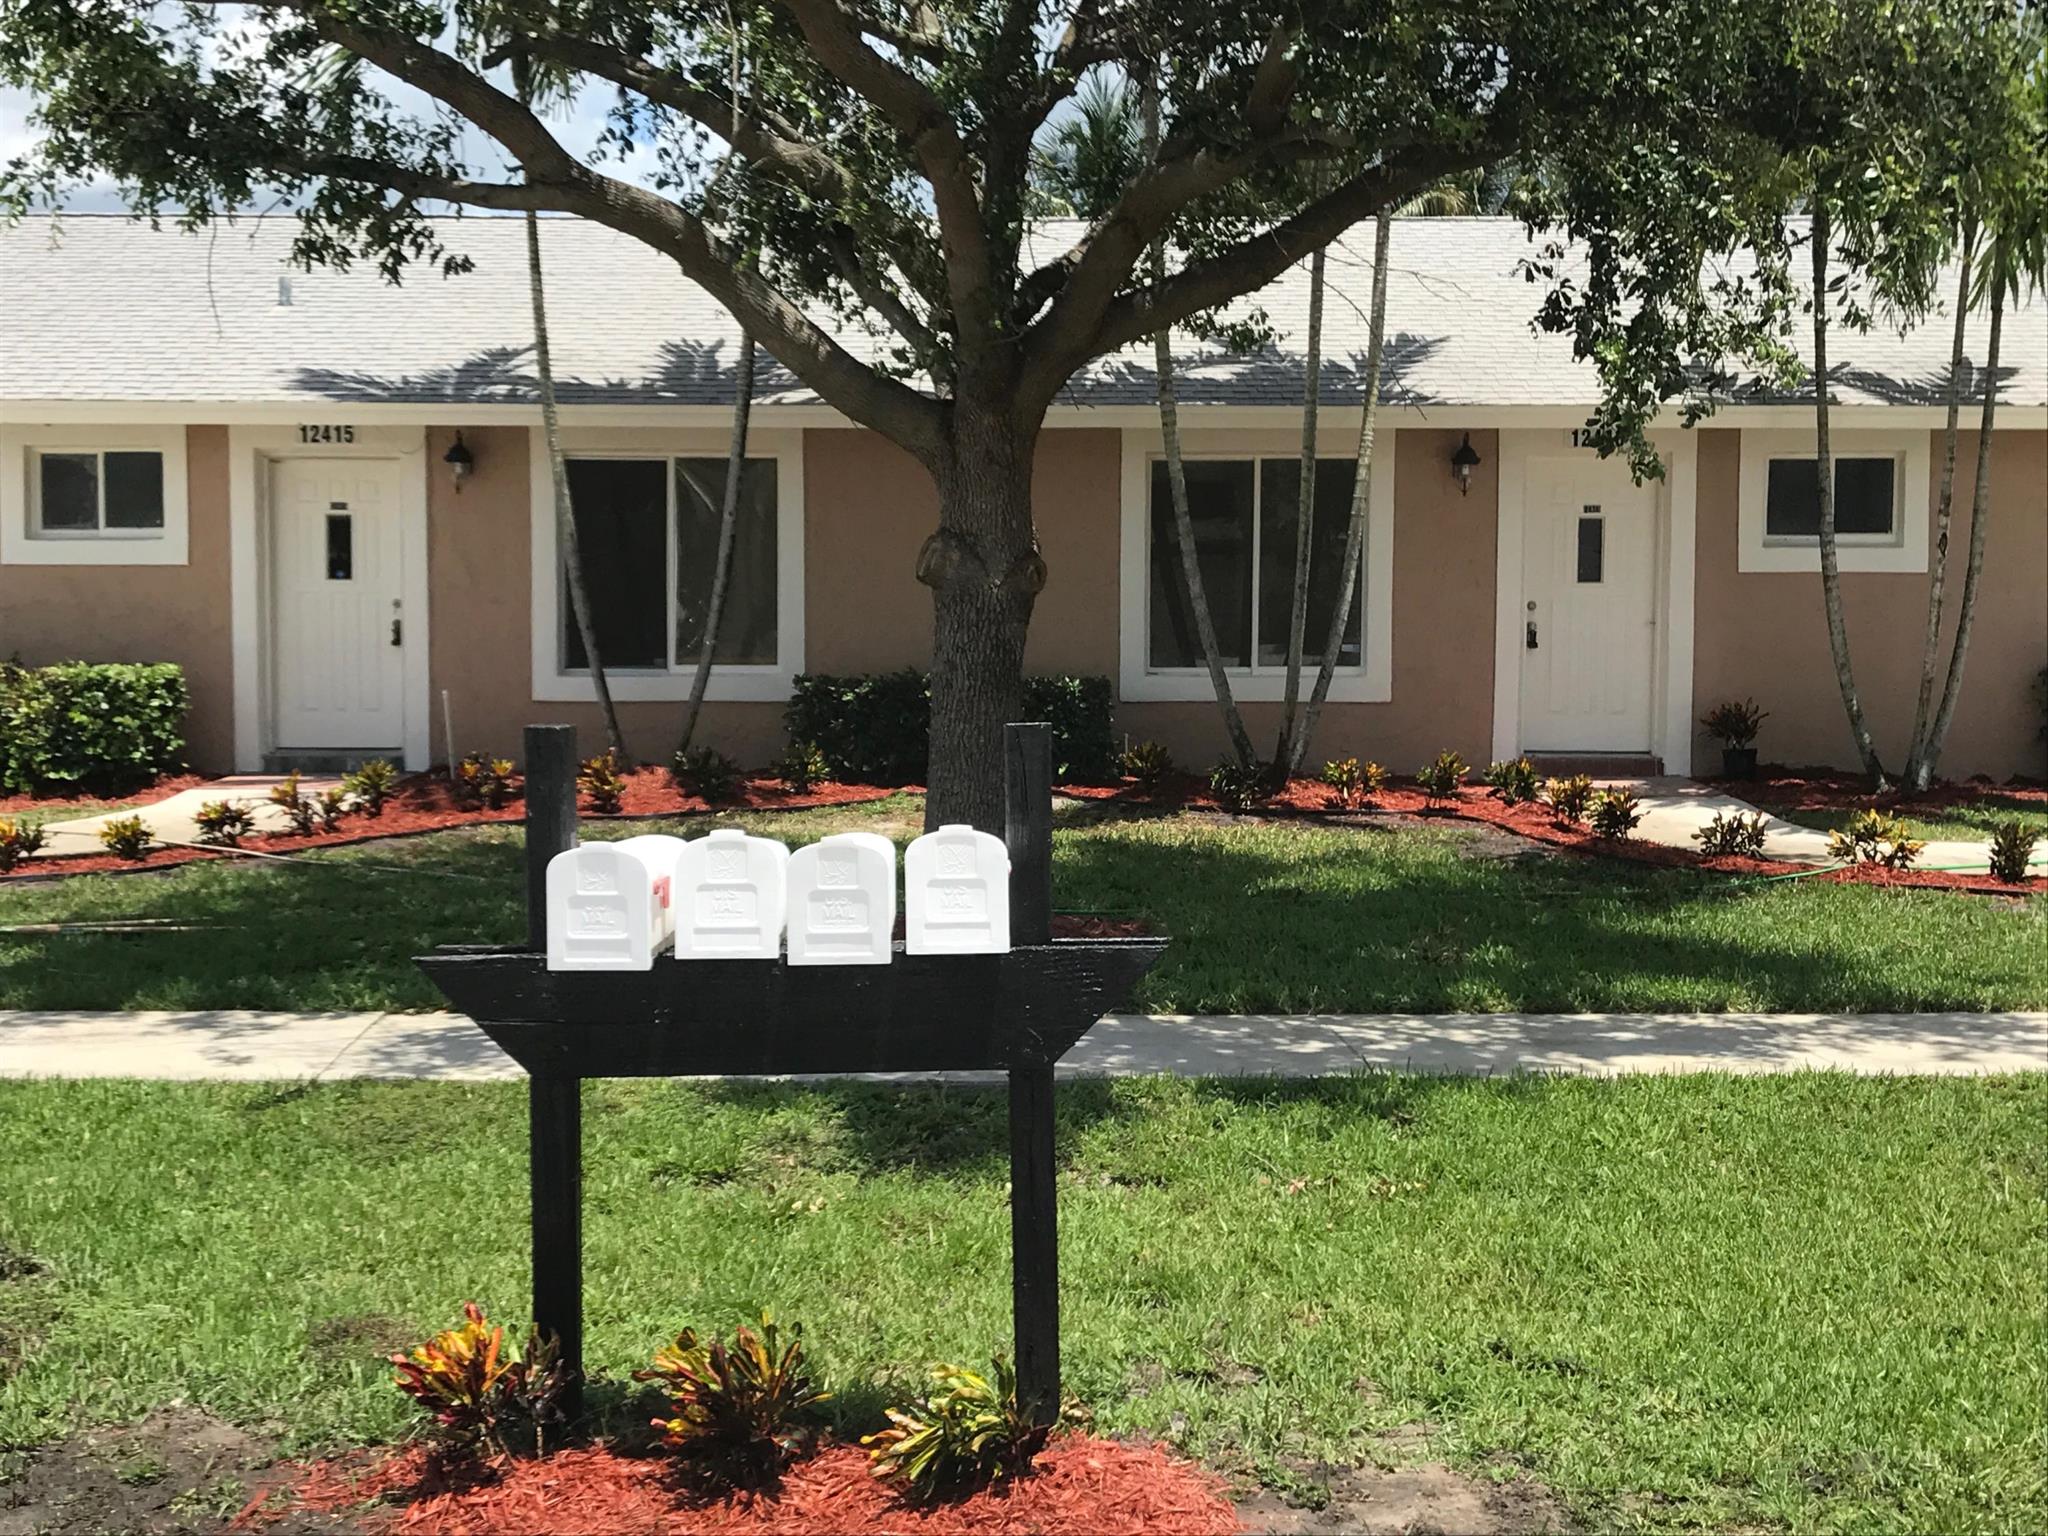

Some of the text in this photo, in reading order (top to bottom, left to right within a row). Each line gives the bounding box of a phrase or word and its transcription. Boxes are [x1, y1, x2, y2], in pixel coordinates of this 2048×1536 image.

[300, 423, 354, 443] 12415
[711, 900, 744, 914] MAIL
[940, 896, 974, 909] MAIL
[582, 912, 616, 926] MAIL
[822, 907, 856, 921] MAIL
